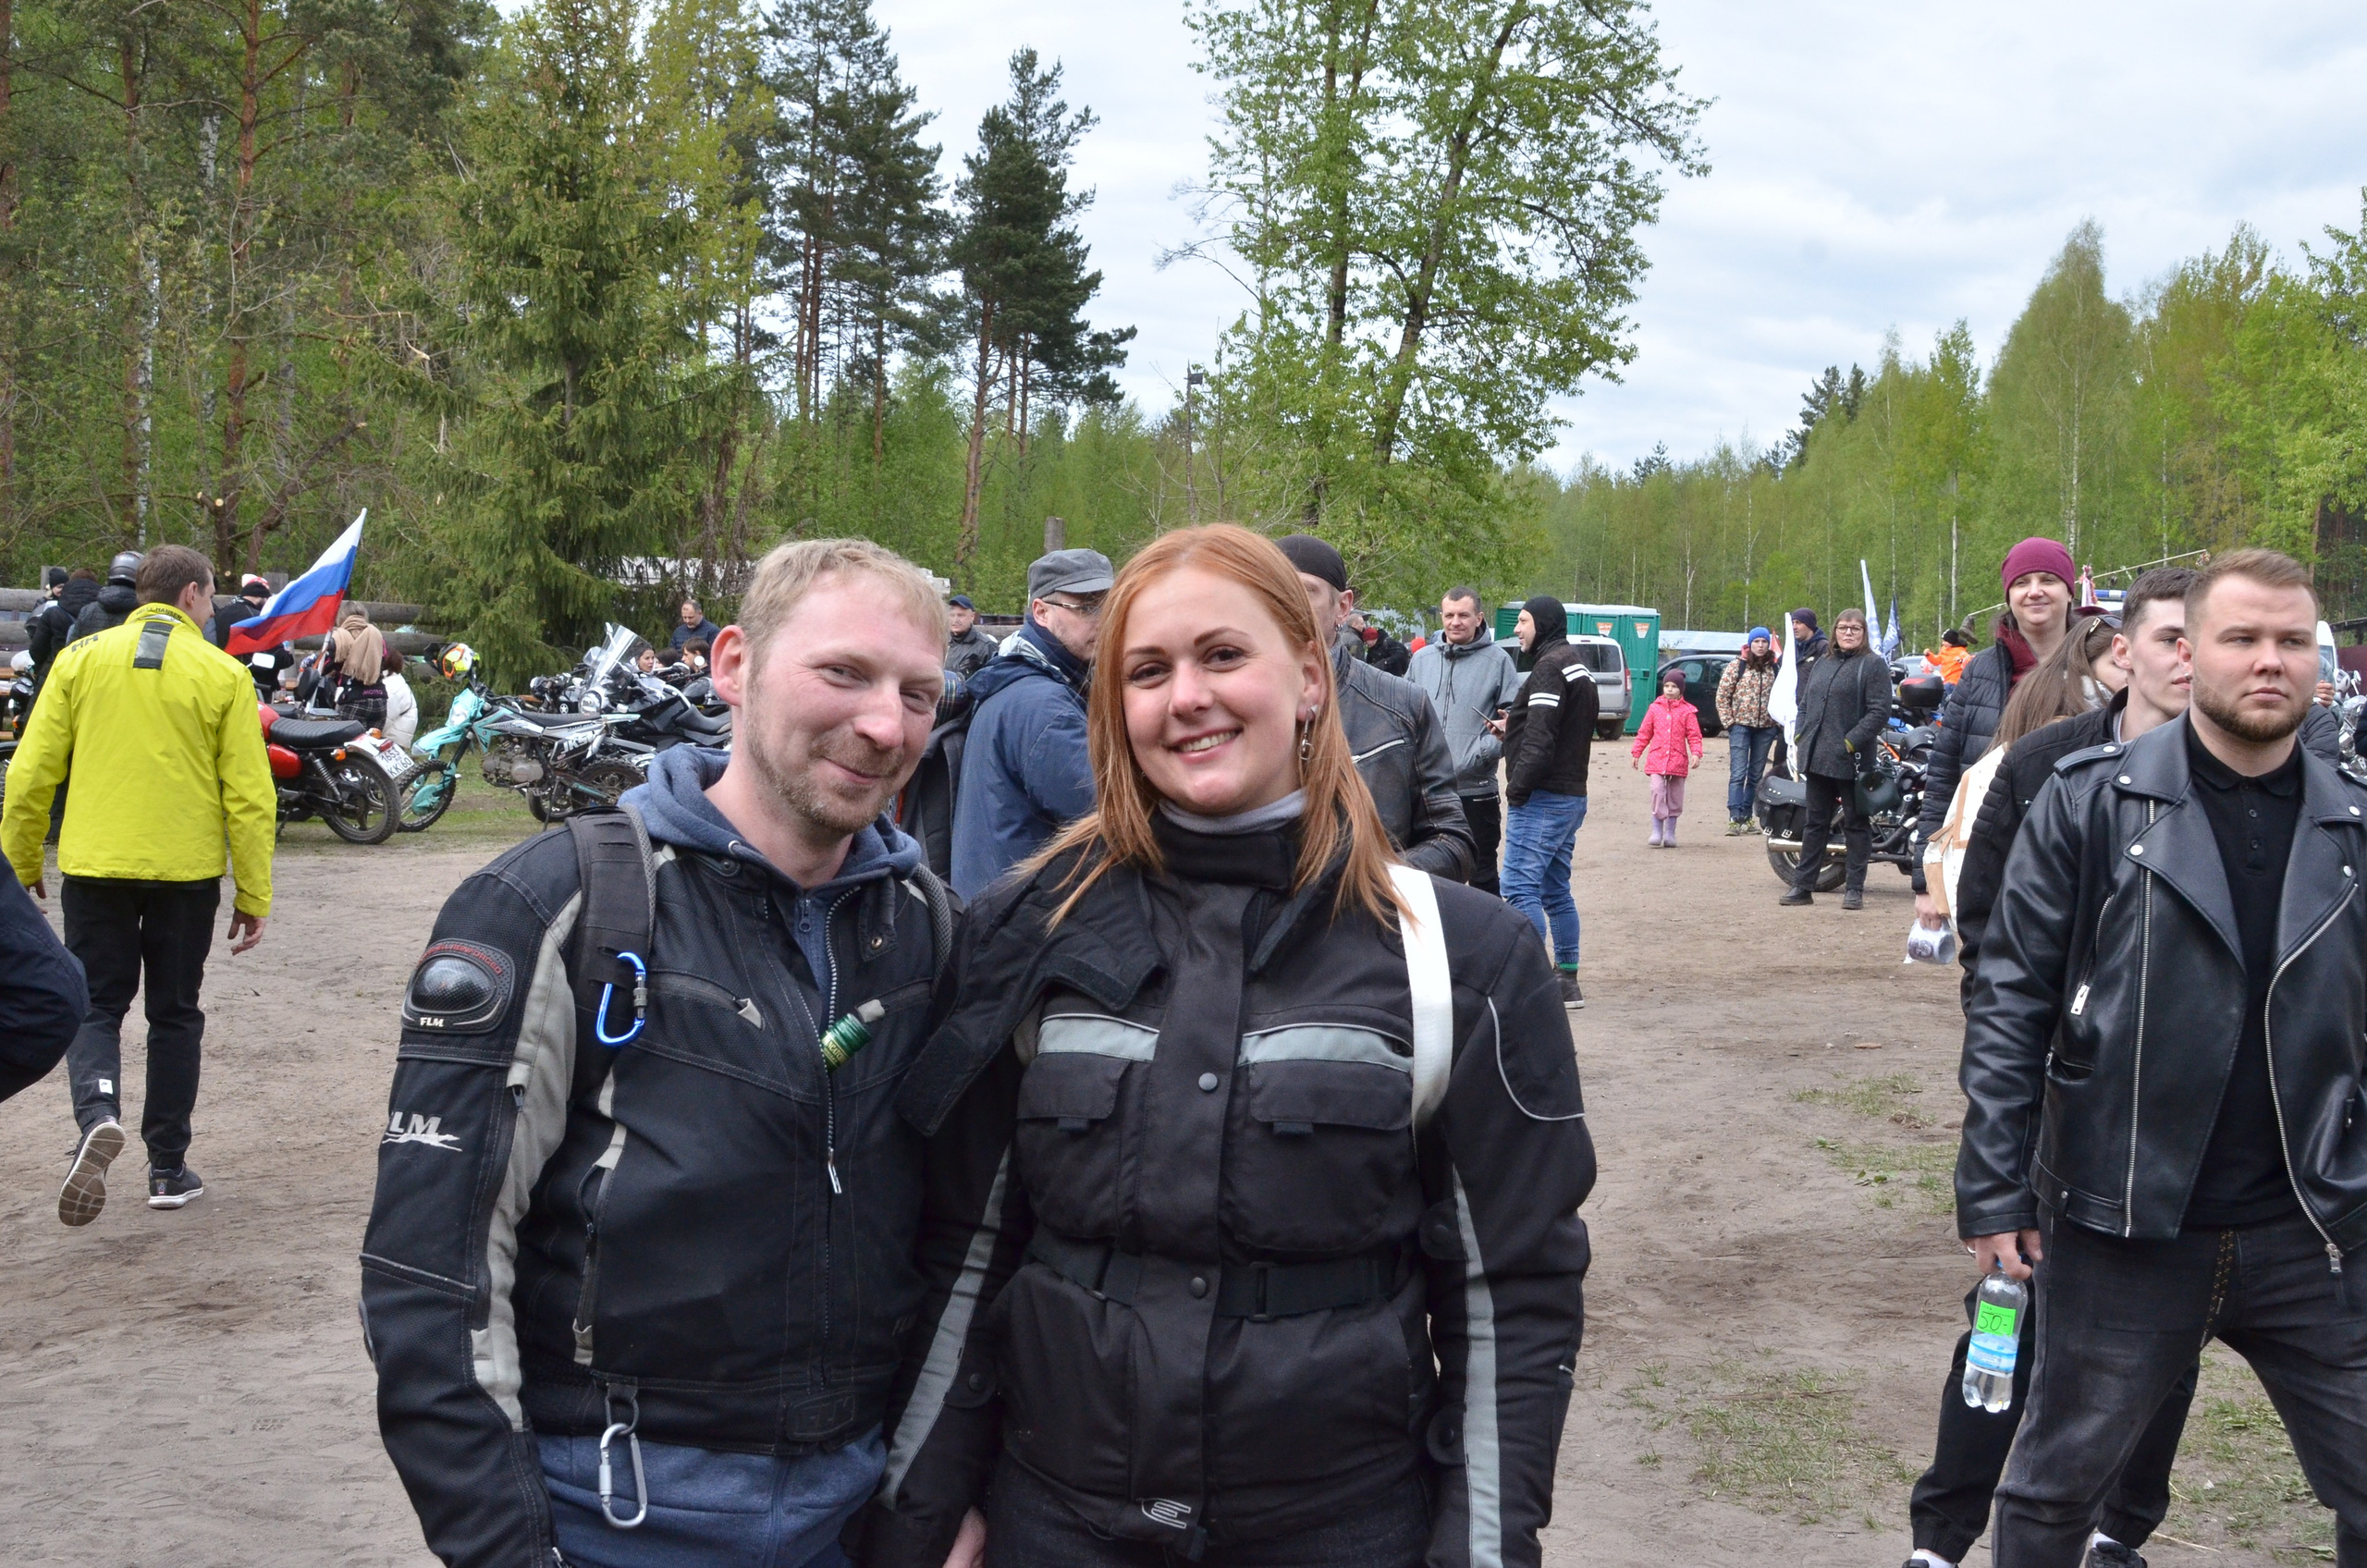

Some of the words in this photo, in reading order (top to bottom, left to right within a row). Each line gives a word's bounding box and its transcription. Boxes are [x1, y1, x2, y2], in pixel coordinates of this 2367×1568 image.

[155, 607, 183, 621] HANSEN
[381, 747, 400, 763] 1653
[387, 763, 400, 777] KK
[401, 757, 412, 769] 60
[451, 944, 503, 975] REINFORCED
[420, 1017, 445, 1027] FLM
[388, 1110, 442, 1138] LM
